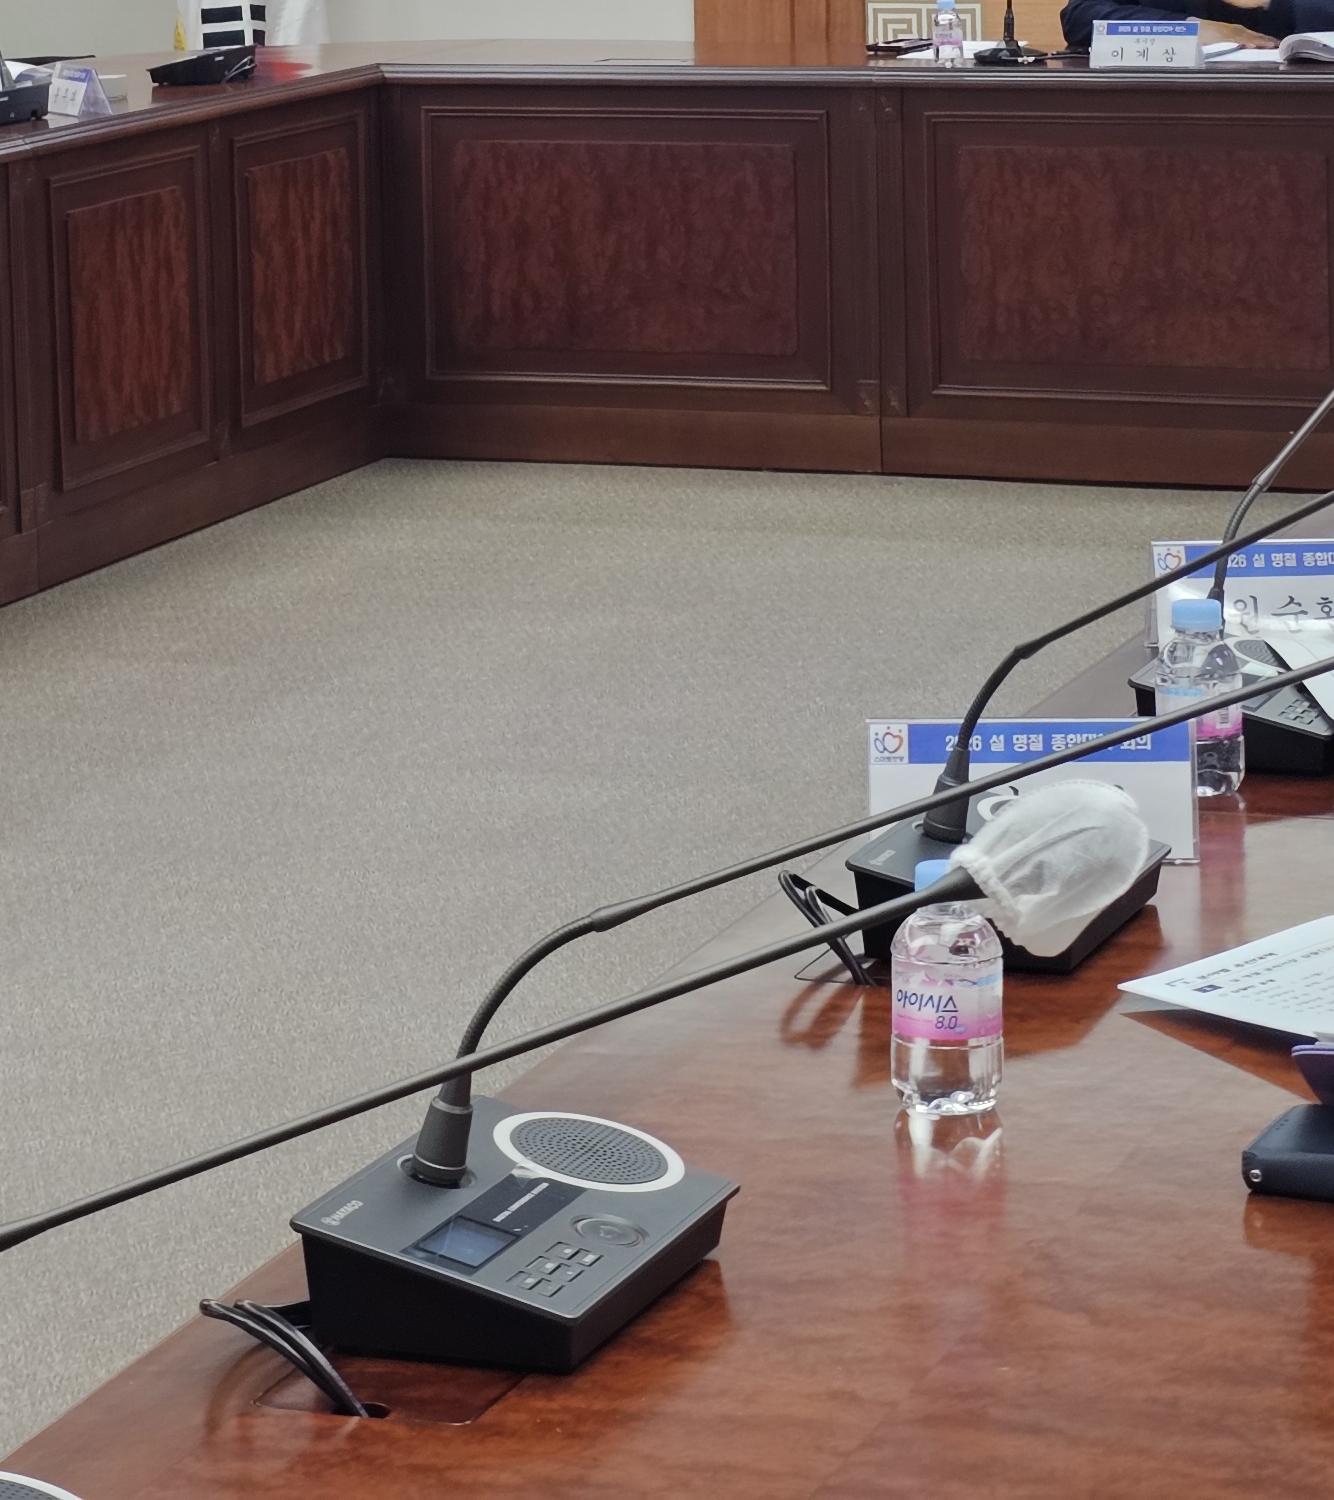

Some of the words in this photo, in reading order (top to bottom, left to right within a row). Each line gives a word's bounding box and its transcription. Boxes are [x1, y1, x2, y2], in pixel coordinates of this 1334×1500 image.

[1226, 553, 1247, 568] 26
[1253, 553, 1266, 567] 설
[1271, 552, 1298, 567] 명절
[945, 734, 983, 751] 26
[989, 734, 1005, 752] 설
[1012, 733, 1044, 752] 명절
[896, 989, 959, 1013] 아이시스
[935, 1015, 959, 1030] 8.0
